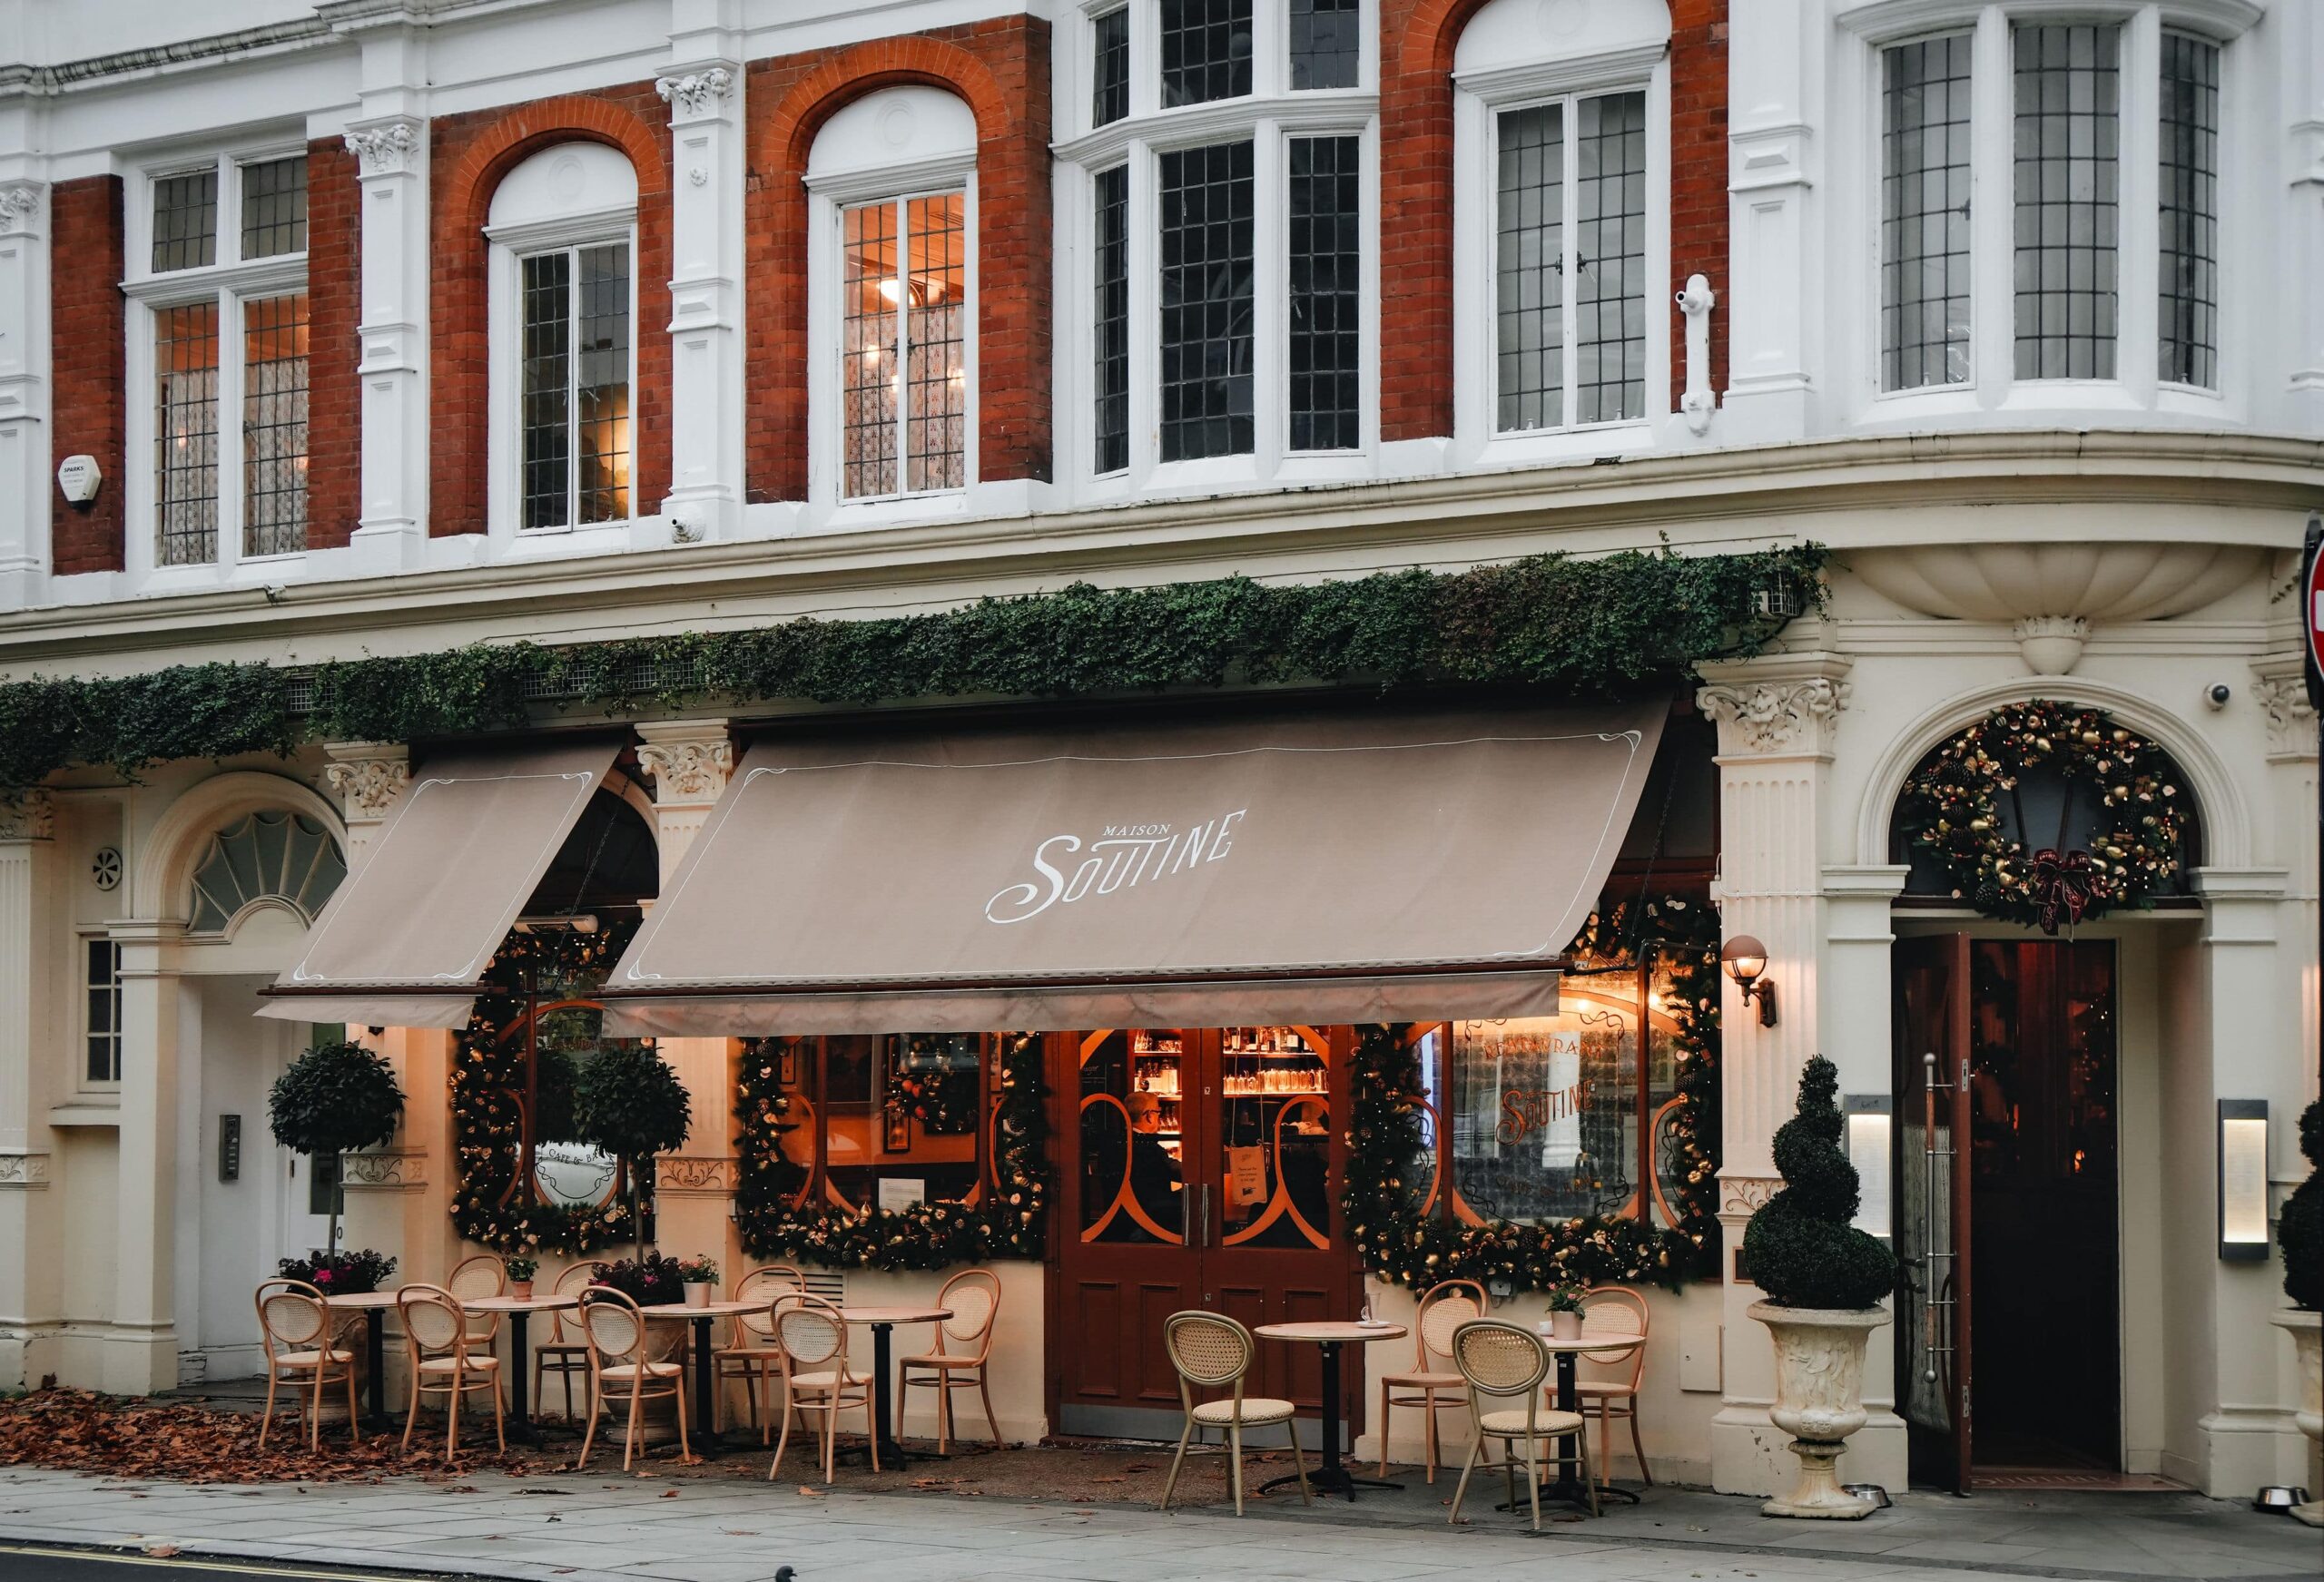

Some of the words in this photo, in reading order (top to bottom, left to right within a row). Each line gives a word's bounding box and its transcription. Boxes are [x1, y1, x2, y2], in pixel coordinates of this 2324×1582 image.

[1102, 823, 1171, 837] MAISON
[573, 1156, 583, 1165] &
[586, 1151, 602, 1163] BA
